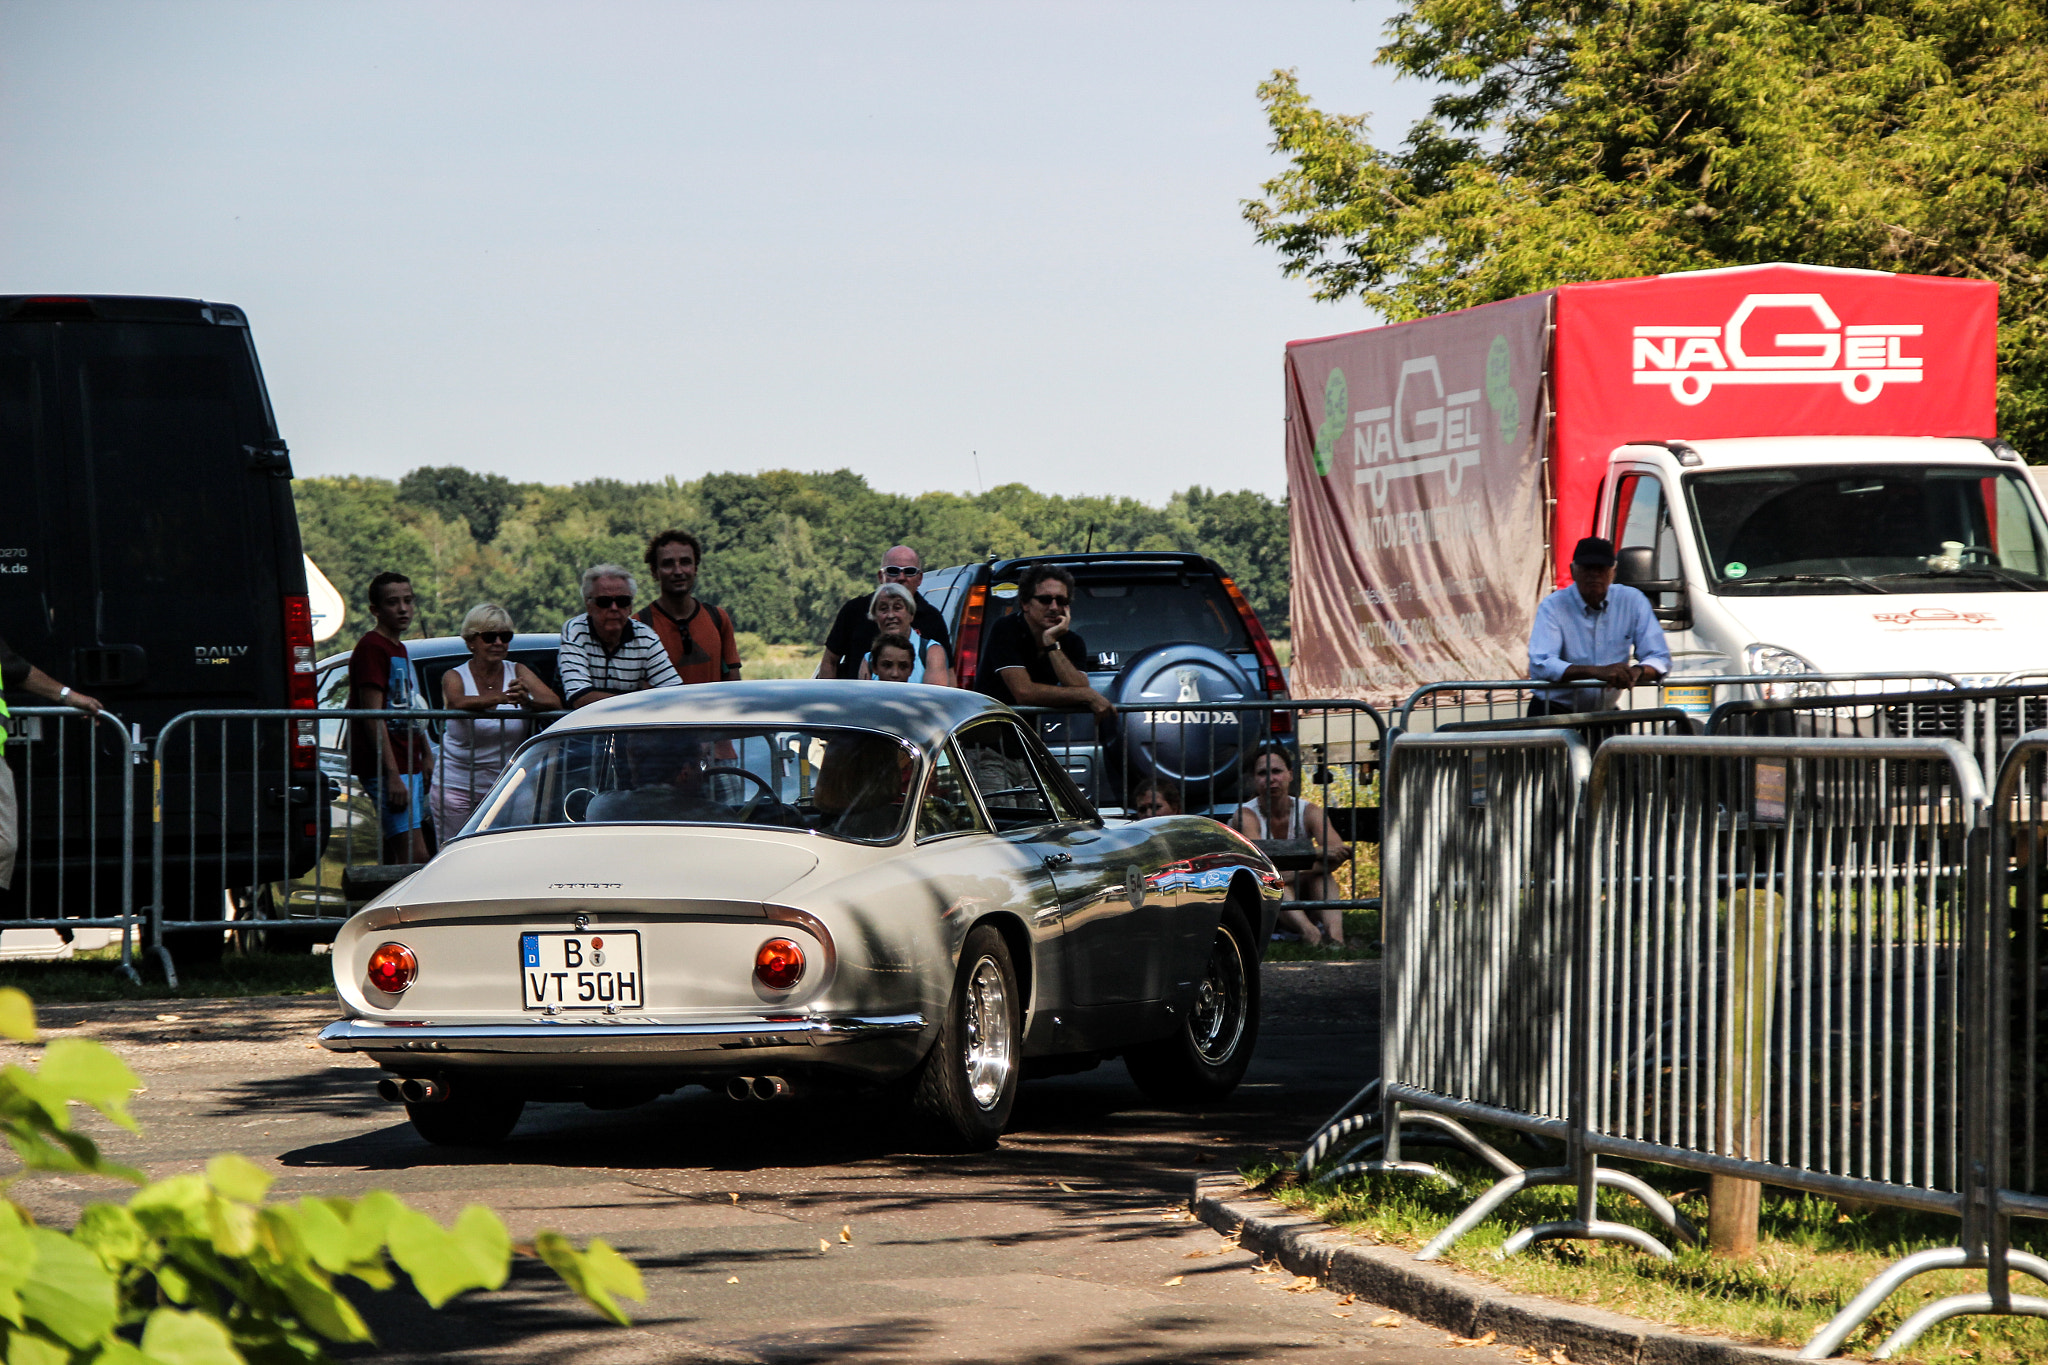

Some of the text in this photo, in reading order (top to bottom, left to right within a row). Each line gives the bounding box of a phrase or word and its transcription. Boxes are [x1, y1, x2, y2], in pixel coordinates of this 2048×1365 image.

[1633, 293, 1924, 370] NAGEL
[1354, 355, 1481, 465] NAGEL
[195, 645, 248, 657] DAILY
[1144, 710, 1239, 725] HONDA
[1129, 872, 1143, 893] 54
[528, 954, 536, 964] D
[563, 938, 583, 969] B
[530, 971, 636, 1002] VT 50H
